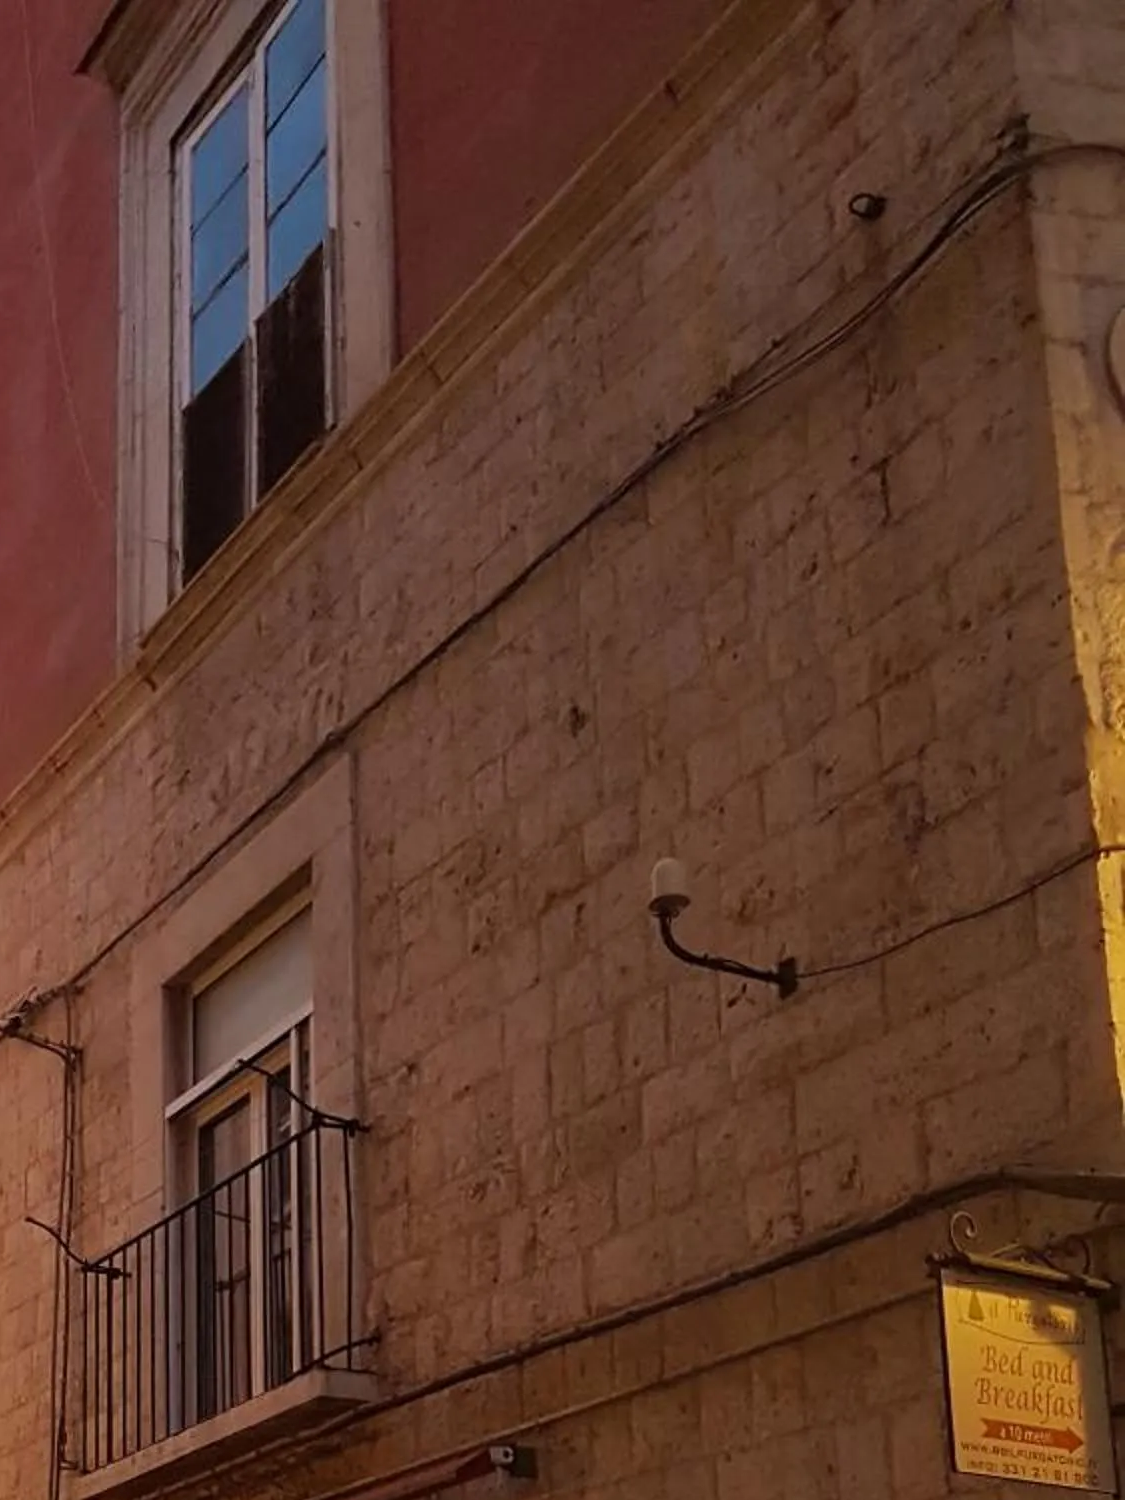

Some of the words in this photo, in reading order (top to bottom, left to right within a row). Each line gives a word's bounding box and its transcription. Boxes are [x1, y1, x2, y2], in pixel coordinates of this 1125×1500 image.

[980, 1345, 1028, 1376] Bed
[1032, 1354, 1077, 1386] and
[974, 1377, 1083, 1424] Breakfast
[1009, 1425, 1022, 1440] 10
